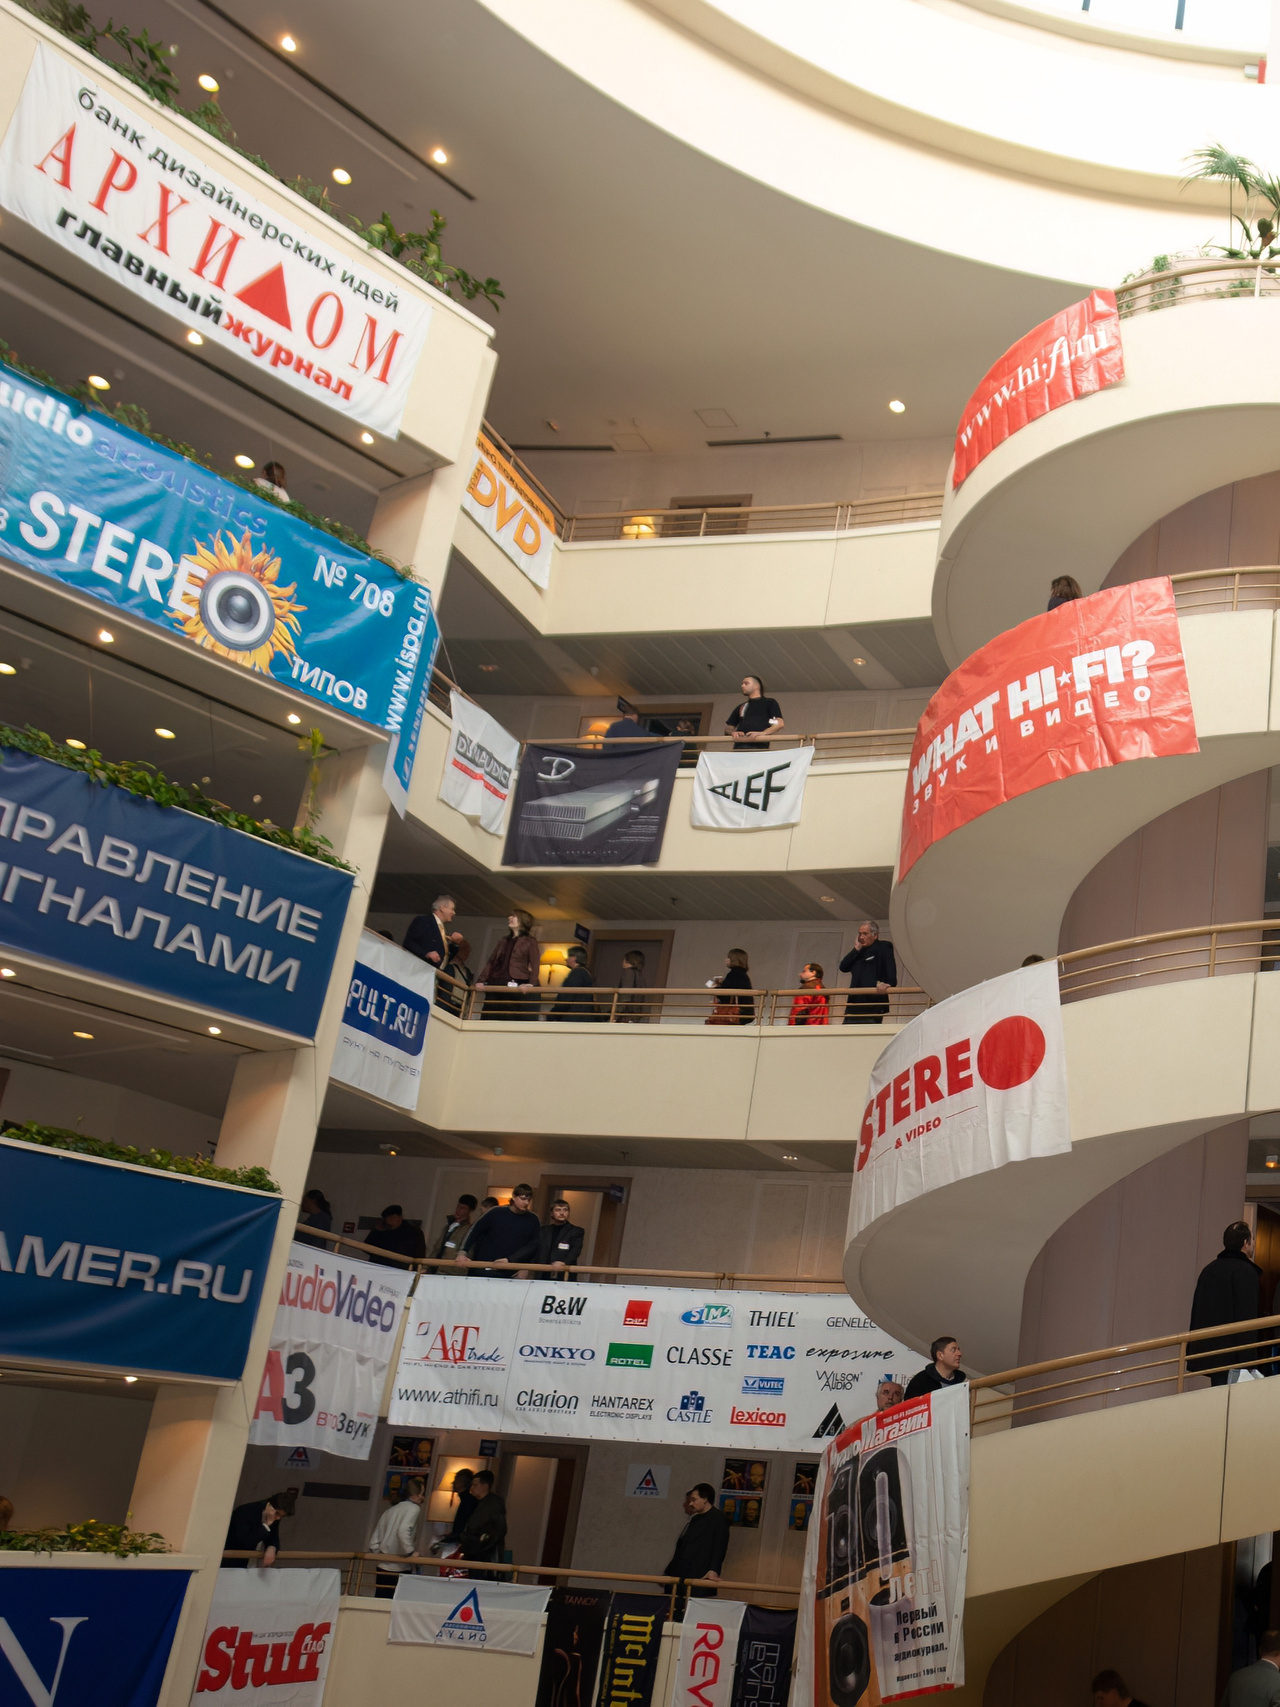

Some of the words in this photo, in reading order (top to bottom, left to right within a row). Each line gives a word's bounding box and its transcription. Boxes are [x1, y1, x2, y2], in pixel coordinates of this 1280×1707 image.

[77, 86, 145, 151] банк
[147, 146, 336, 276] дизайнерских
[341, 268, 400, 313] идей
[55, 206, 223, 326] главный
[220, 311, 353, 401] журнал
[93, 434, 268, 537] acoustics
[466, 459, 541, 556] DVD
[350, 574, 395, 617] 708
[385, 587, 432, 732] www.ispa.ru
[292, 656, 368, 710] ТИПОВ
[911, 753, 969, 815] ЗВУК
[985, 735, 998, 754] И
[1020, 685, 1151, 738] ВИДЕО
[912, 690, 1000, 797] WHAT
[707, 761, 791, 812] ALEF
[0, 861, 301, 993] ГНАЛАМИ
[905, 1116, 942, 1142] VIDEO
[541, 1295, 588, 1316] B&W
[750, 1310, 796, 1328] THIEL
[519, 1344, 595, 1361] ONKYO
[610, 1357, 649, 1366] ROTEL
[746, 1344, 796, 1360] TEAC
[806, 1347, 895, 1363] exposure
[759, 1380, 784, 1389] VUTEC
[816, 1370, 861, 1383] WILSON
[820, 1380, 853, 1392] AUDIO
[398, 1387, 498, 1408] www.athifi.ru
[516, 1389, 579, 1410] clarion
[591, 1395, 655, 1411] HANTAREX
[666, 1407, 714, 1424] CASTLE
[730, 1406, 786, 1426] lexicon
[895, 1602, 938, 1627] Первый
[902, 1621, 945, 1643] России
[196, 1622, 332, 1693] Stuff
